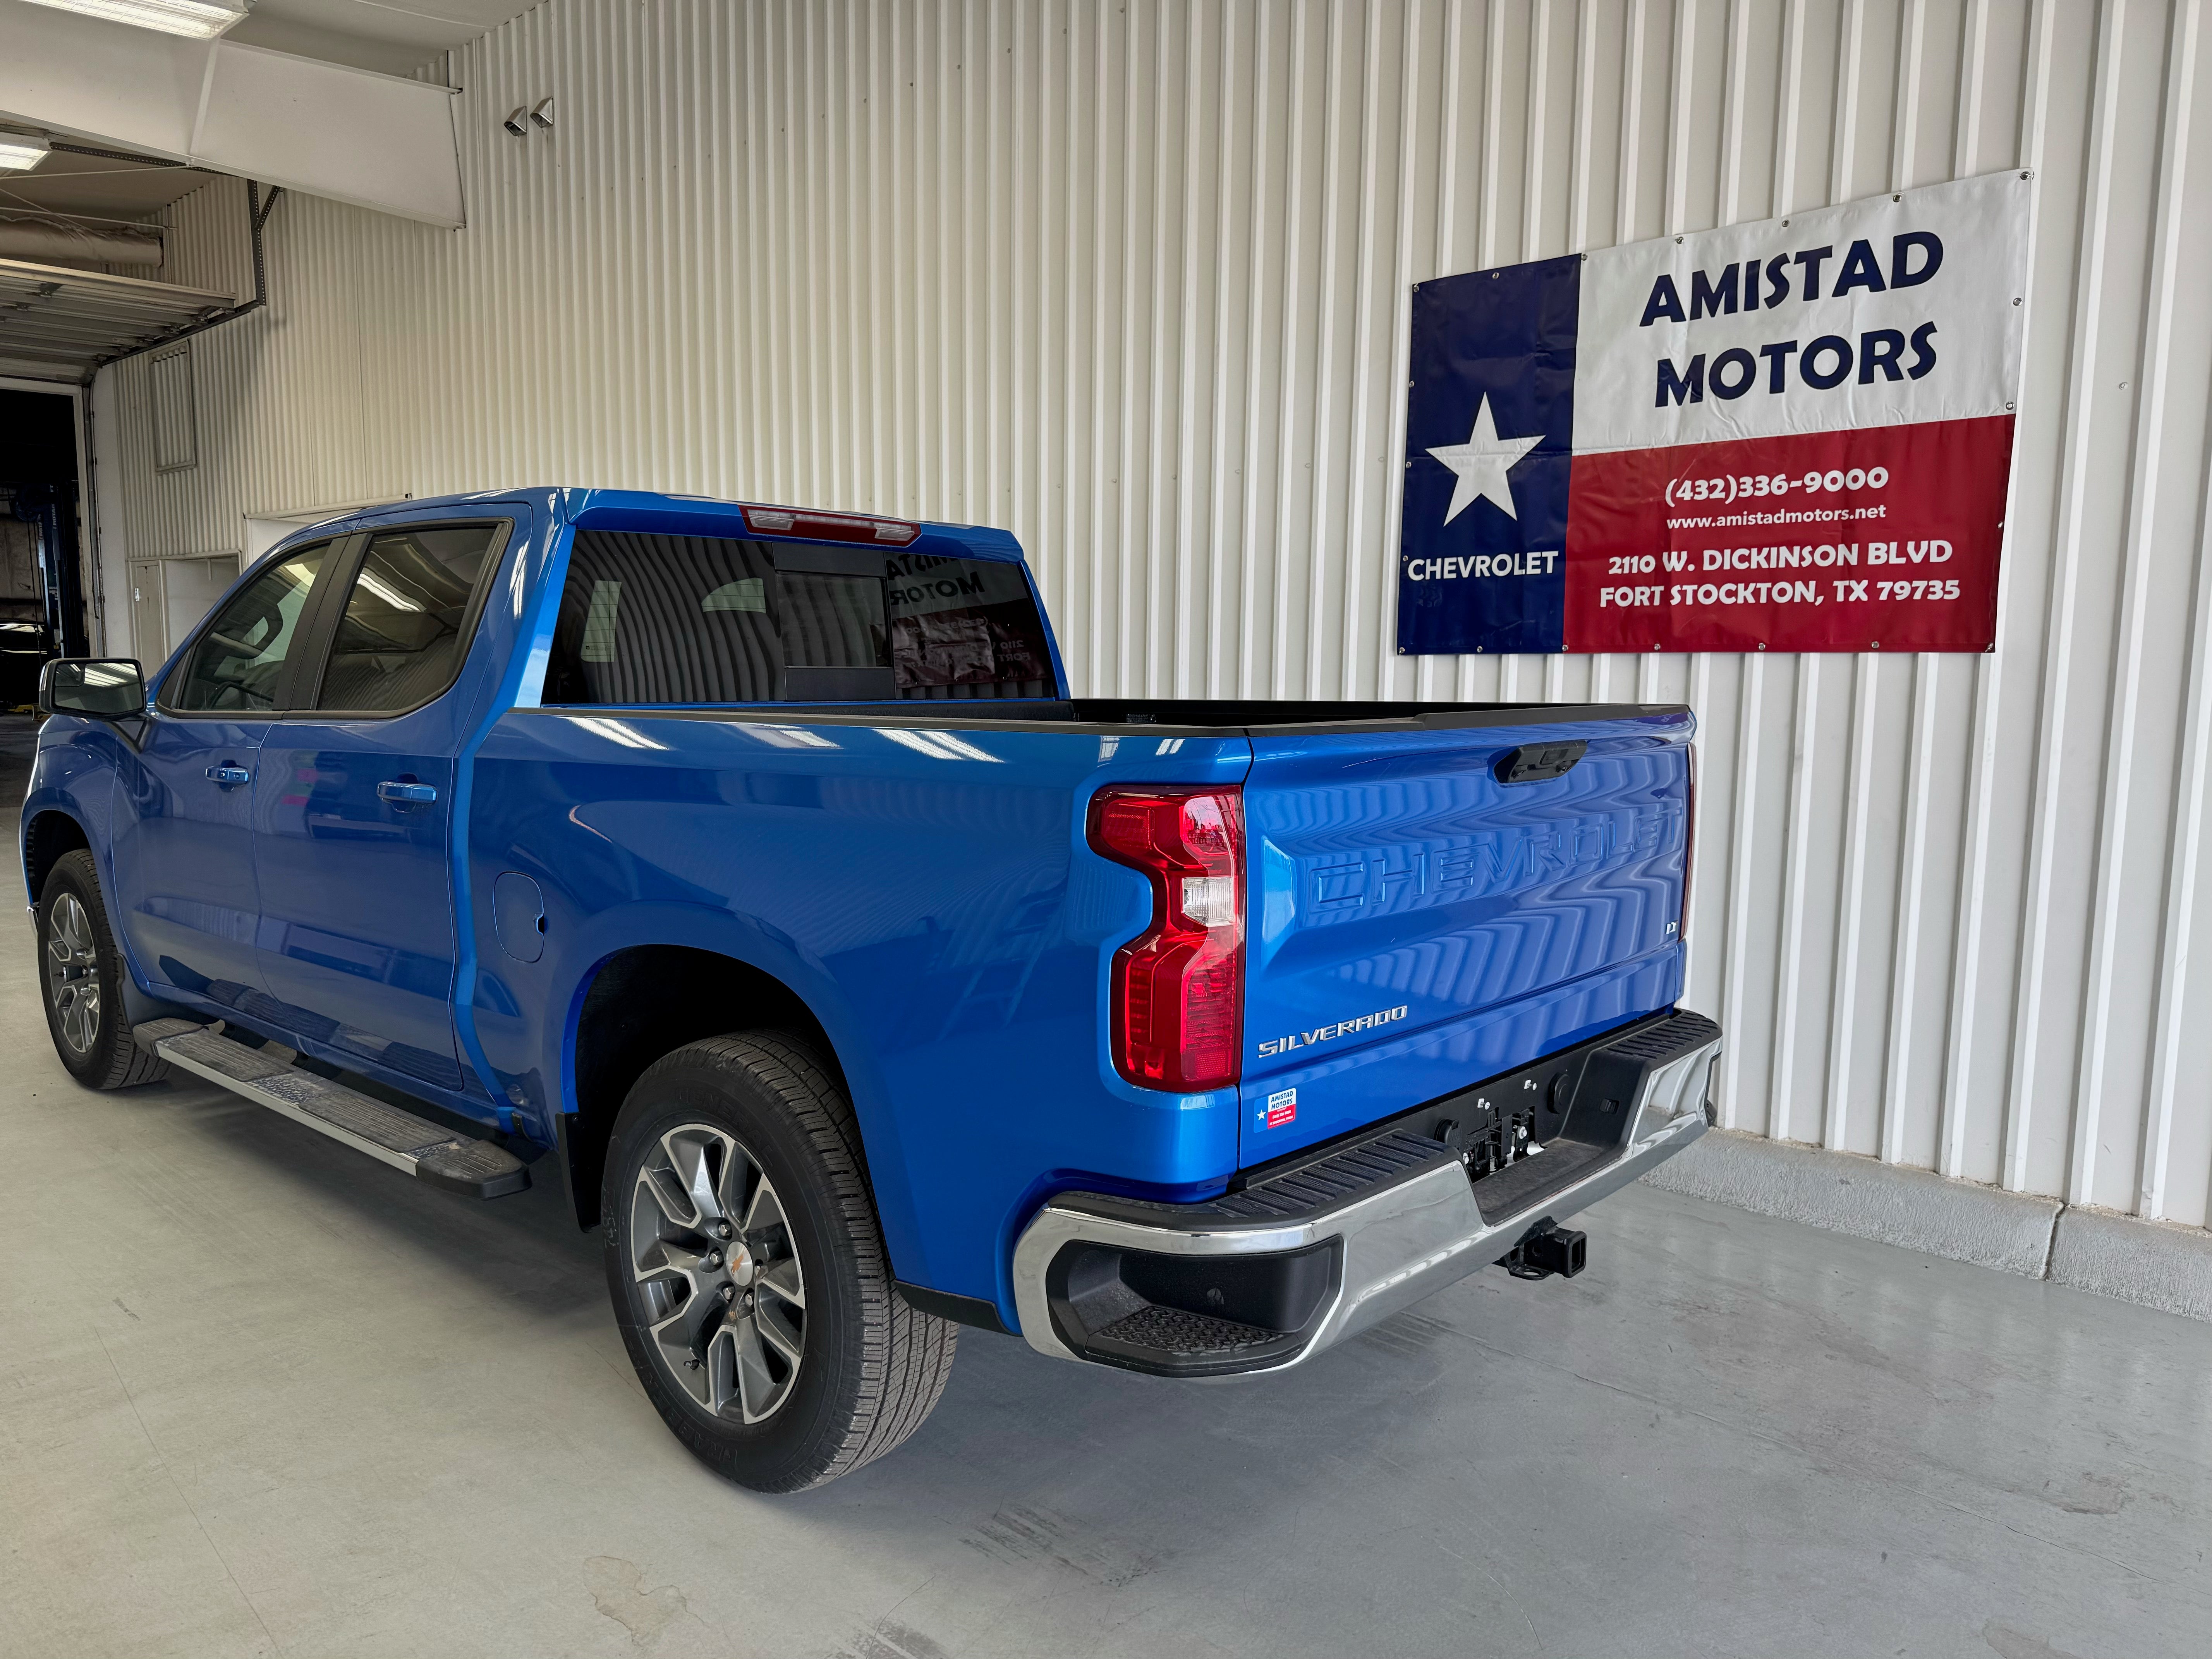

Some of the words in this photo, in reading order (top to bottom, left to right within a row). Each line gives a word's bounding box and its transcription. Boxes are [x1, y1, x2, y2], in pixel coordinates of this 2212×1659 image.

[1639, 230, 1944, 327] AMISTAD
[1654, 321, 1938, 408] MOTORS
[1665, 466, 1889, 507] (432)336-9000
[1666, 504, 1886, 529] www.amistadmotors.net
[1408, 551, 1559, 581] CHEVROLET
[1609, 555, 1656, 575] 2110
[1662, 551, 1695, 572] W.
[1703, 543, 1858, 571] DICKINSON
[1867, 540, 1953, 565] BLVD
[1600, 586, 1664, 607] FORT
[1670, 581, 1824, 606] STOCKTON,
[1832, 580, 1868, 602] TX
[1877, 580, 1960, 601] 79735
[1309, 805, 1683, 915] CHEVROLET
[1258, 1005, 1408, 1058] SILVERADO
[1271, 1091, 1293, 1103] AMISTAD
[1271, 1098, 1293, 1110] MOTORS
